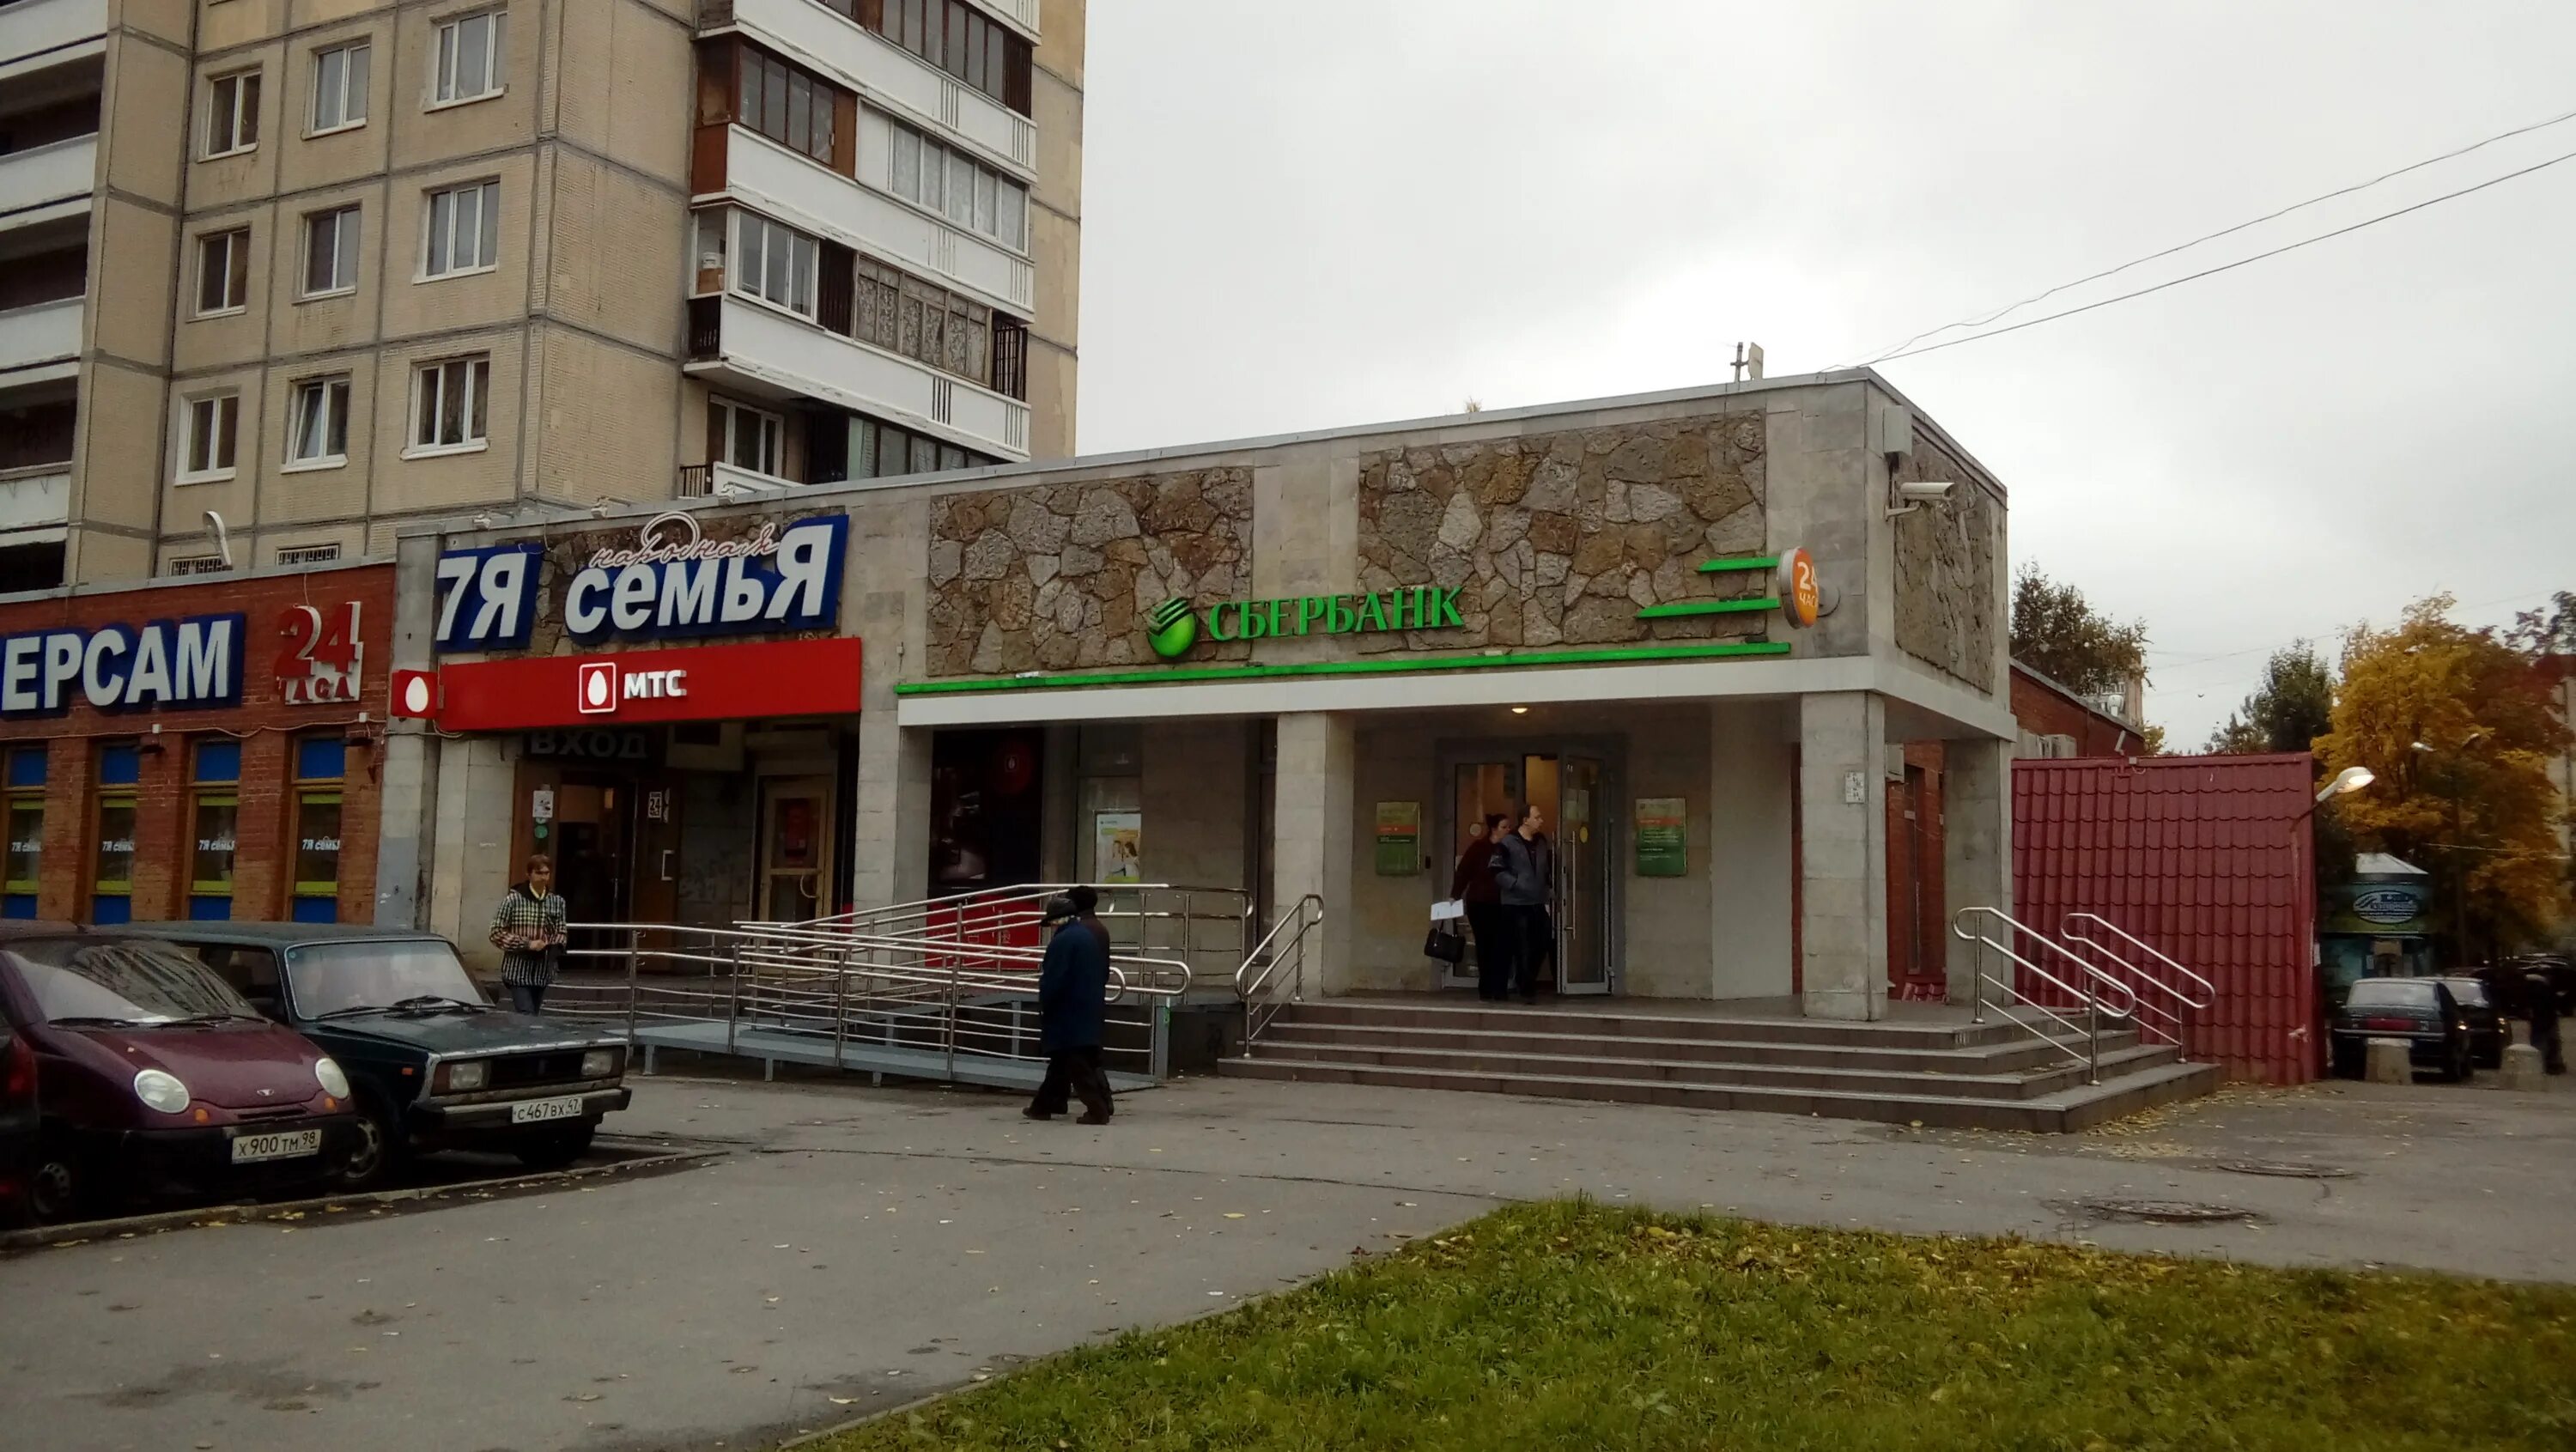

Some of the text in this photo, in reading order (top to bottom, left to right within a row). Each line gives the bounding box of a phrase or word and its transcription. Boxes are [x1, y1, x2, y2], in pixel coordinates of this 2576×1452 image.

[436, 551, 526, 641] 7Я
[1208, 584, 1465, 642] СБЕРБАНК
[2, 620, 232, 711] ЕРСАМ
[274, 601, 363, 677] 24
[623, 669, 687, 700] МТС
[531, 729, 648, 758] ВХОД
